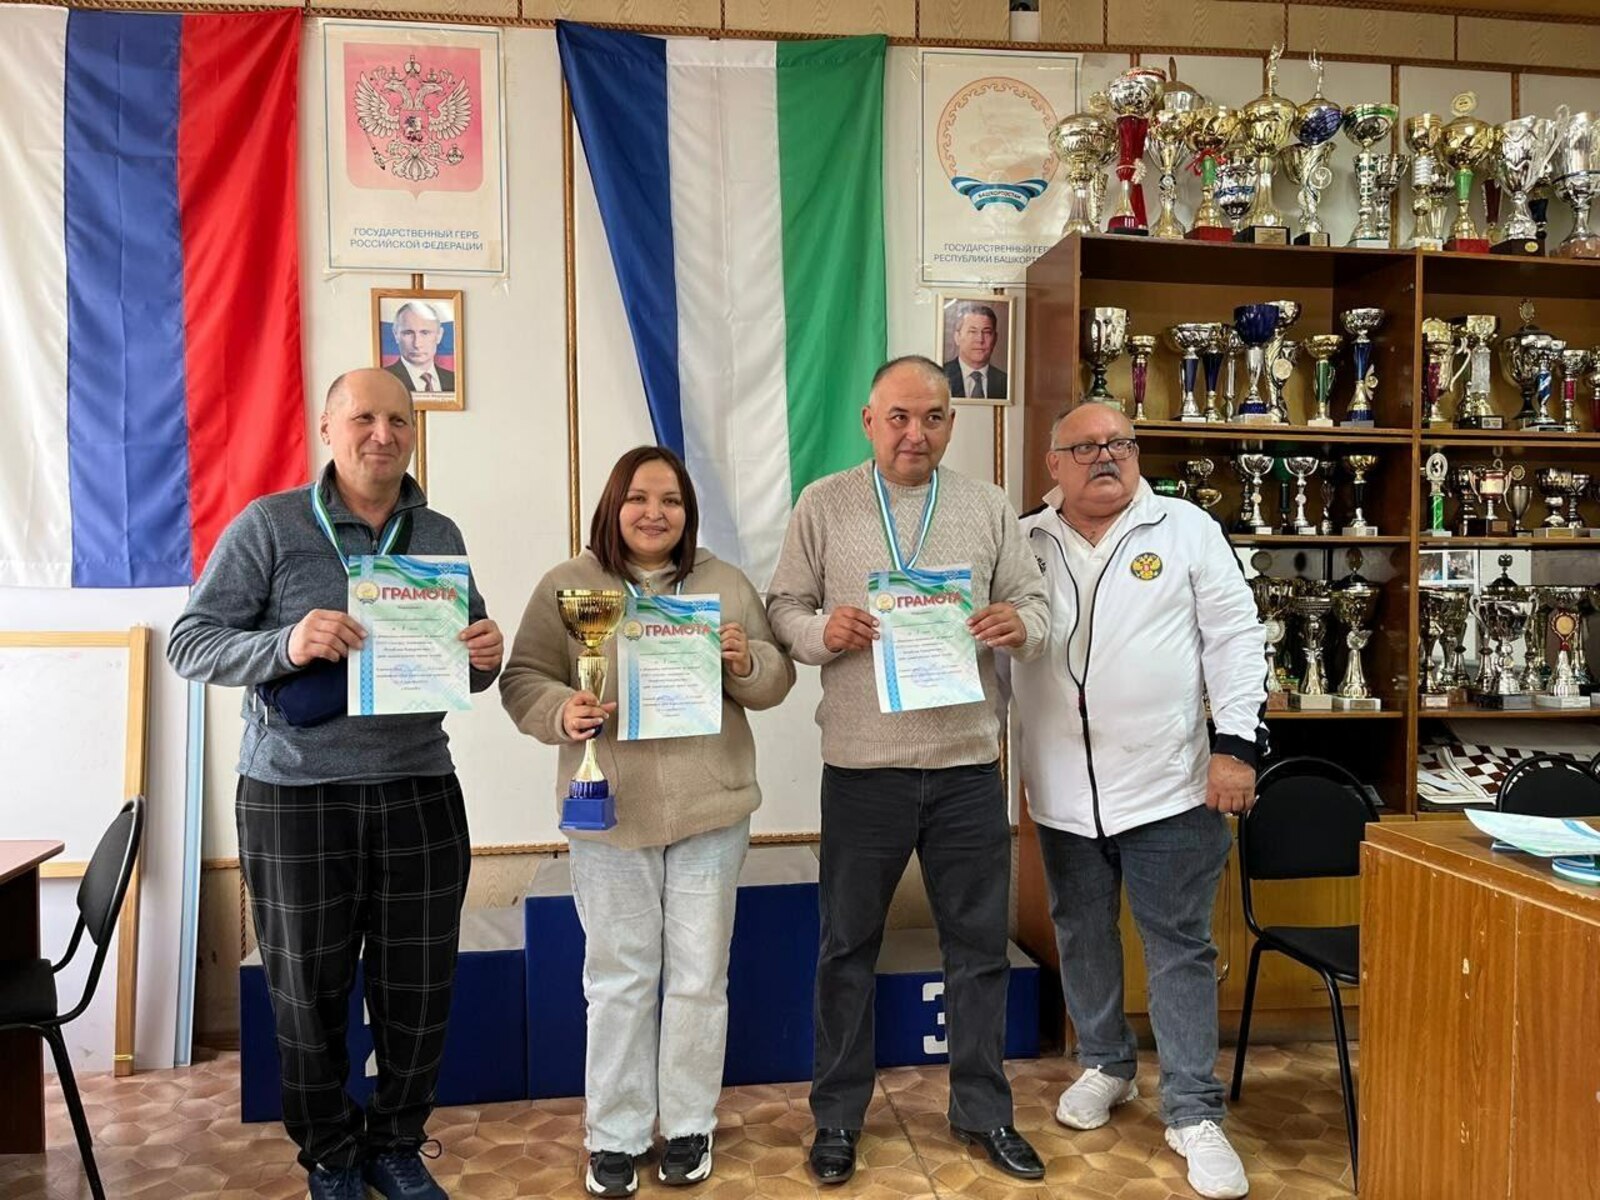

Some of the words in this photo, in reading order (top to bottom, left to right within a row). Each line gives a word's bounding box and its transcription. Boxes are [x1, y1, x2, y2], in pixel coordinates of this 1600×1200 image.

[353, 227, 454, 239] ГОСУДАРСТВЕННЫЙ
[455, 230, 480, 240] ГЕРБ
[350, 239, 421, 250] РОССИЙСКОЙ
[422, 241, 483, 251] ФЕДЕРАЦИИ
[944, 243, 1032, 254] ГОСУДАРСТВЕННЫЙ
[1033, 246, 1051, 254] ГЕР
[934, 254, 993, 264] РЕСПУБЛИКИ
[1433, 459, 1441, 476] 3
[382, 587, 457, 600] ГРАМОТА
[896, 591, 963, 608] ГРАМОТА
